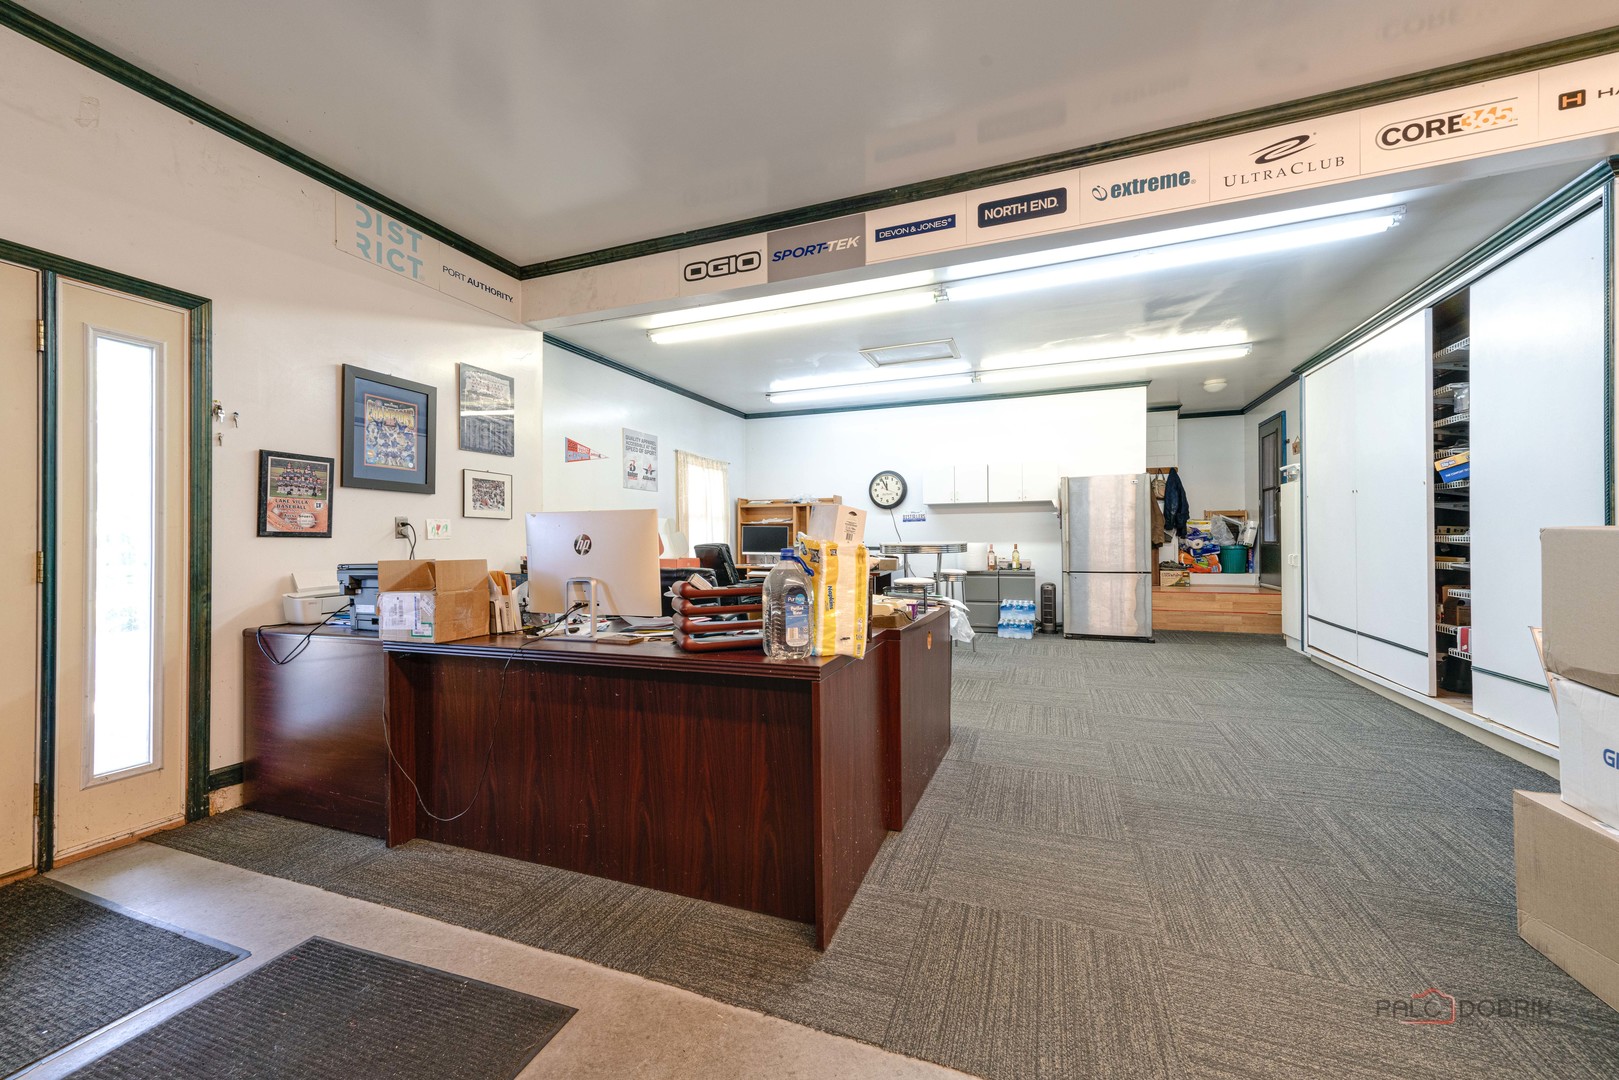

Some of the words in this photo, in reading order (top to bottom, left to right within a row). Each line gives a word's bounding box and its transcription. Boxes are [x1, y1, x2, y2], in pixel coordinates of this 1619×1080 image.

[1110, 170, 1191, 199] extreme
[984, 203, 1027, 221] NORTH
[879, 226, 909, 239] DEVON
[910, 225, 917, 233] &
[772, 235, 859, 262] SPORT-TEK
[683, 251, 762, 282] OGIO
[442, 265, 466, 281] PORT
[467, 277, 514, 303] AUTHORITY
[625, 434, 641, 443] QUALITY
[641, 438, 657, 447] APPAREL
[625, 440, 646, 449] ACCESSIBLE
[625, 445, 638, 453] SPEED
[574, 534, 592, 556] hp
[827, 585, 835, 610] Napkins
